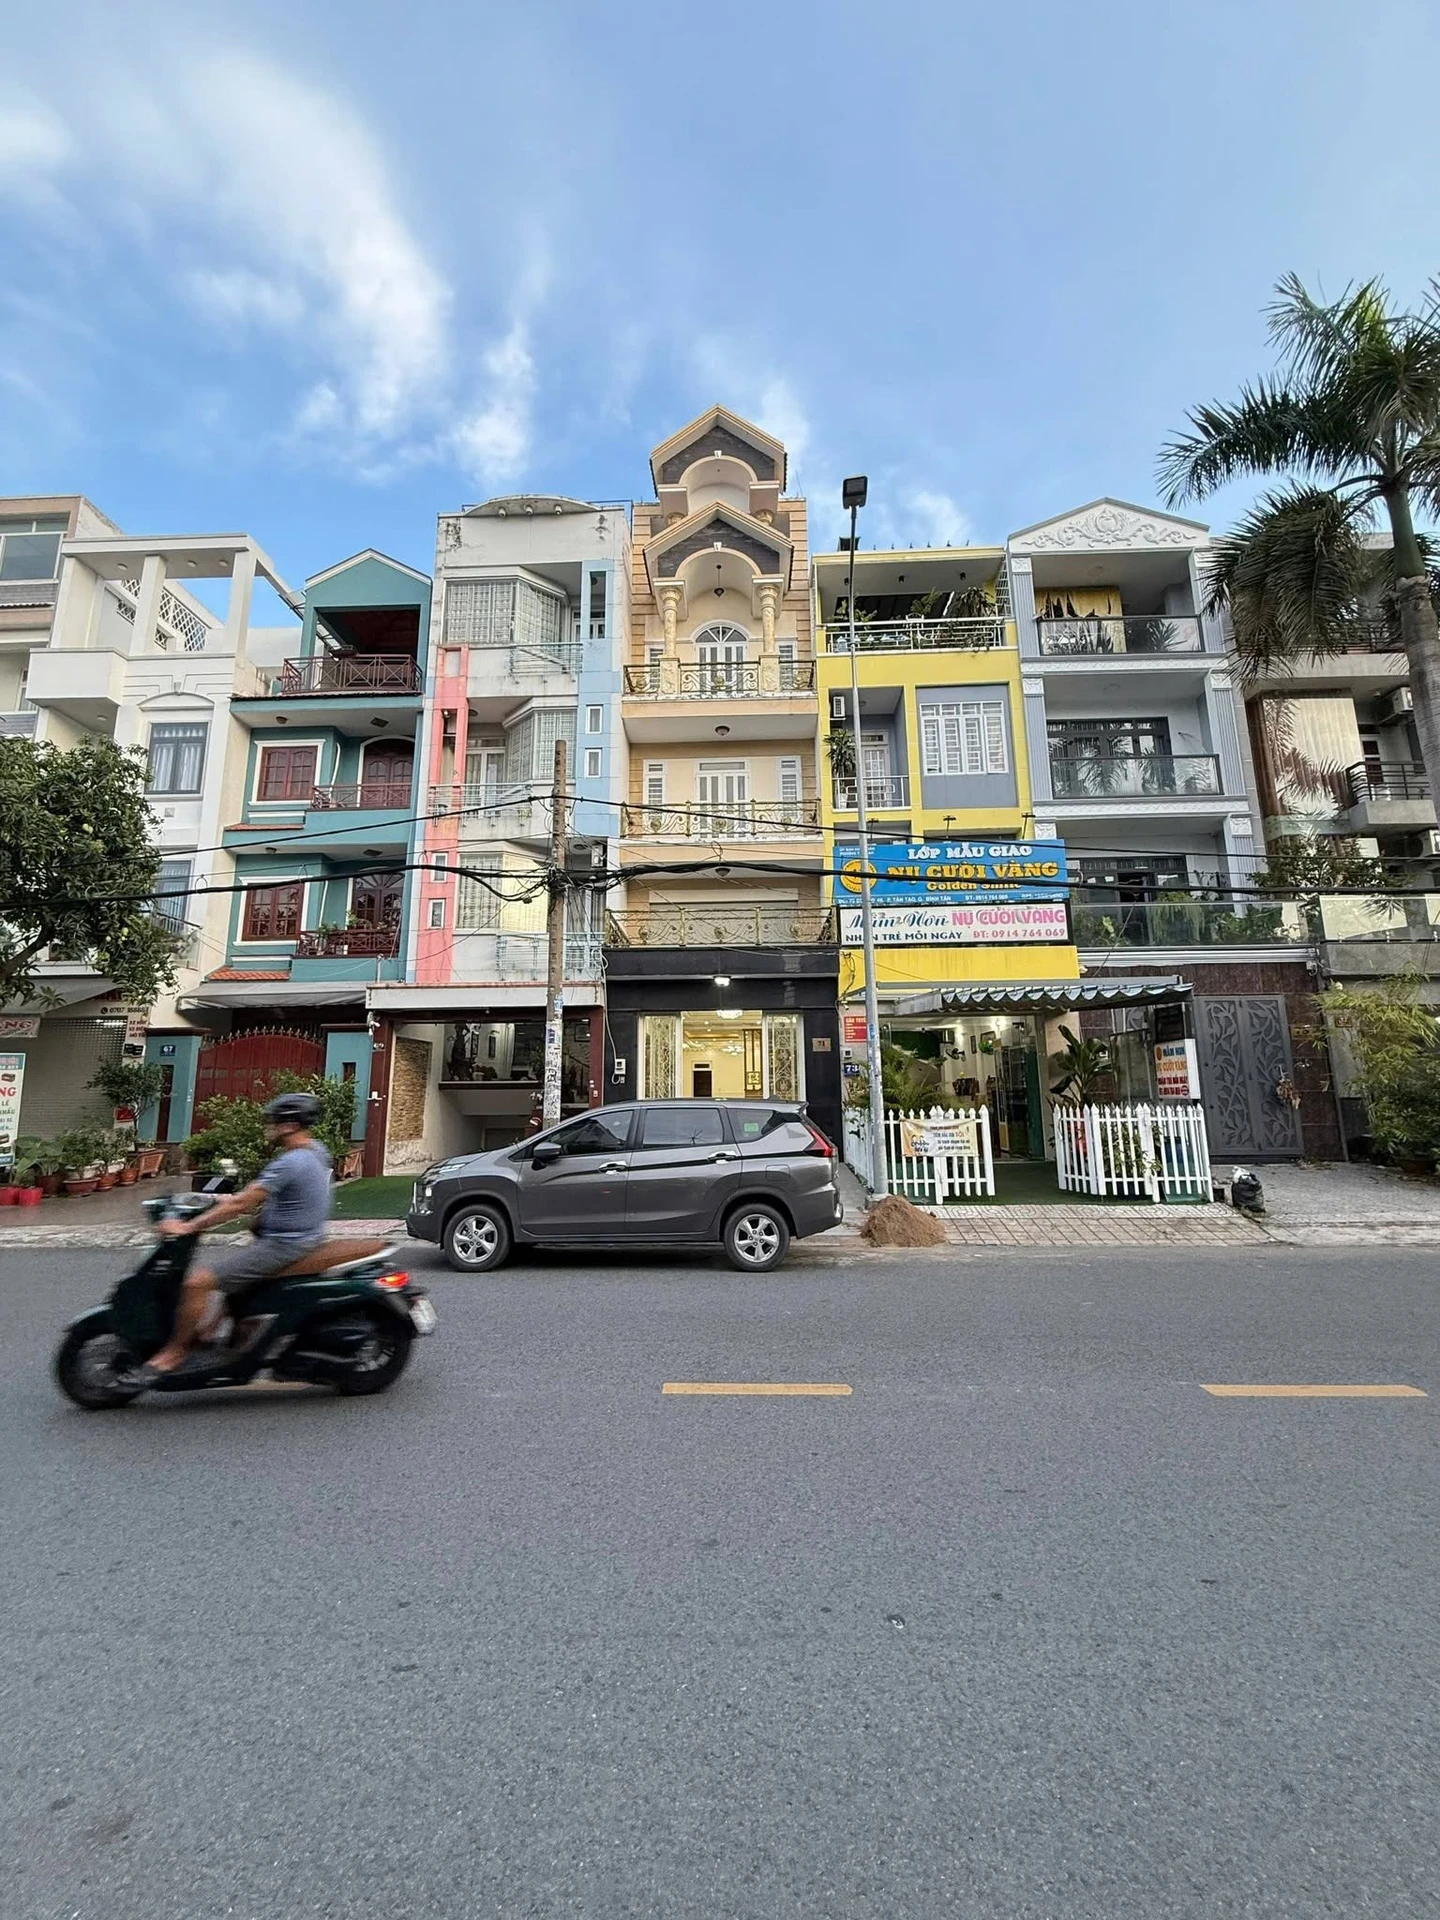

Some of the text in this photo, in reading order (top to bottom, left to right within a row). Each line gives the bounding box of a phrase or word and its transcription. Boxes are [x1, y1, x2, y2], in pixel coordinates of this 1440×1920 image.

[908, 845, 940, 860] LỚP
[993, 860, 1059, 878] VÀNG
[931, 930, 962, 940] NGÀY
[991, 930, 1018, 938] 0914
[1022, 929, 1042, 937] 764
[1045, 928, 1065, 937] 069
[845, 1064, 858, 1072] 73
